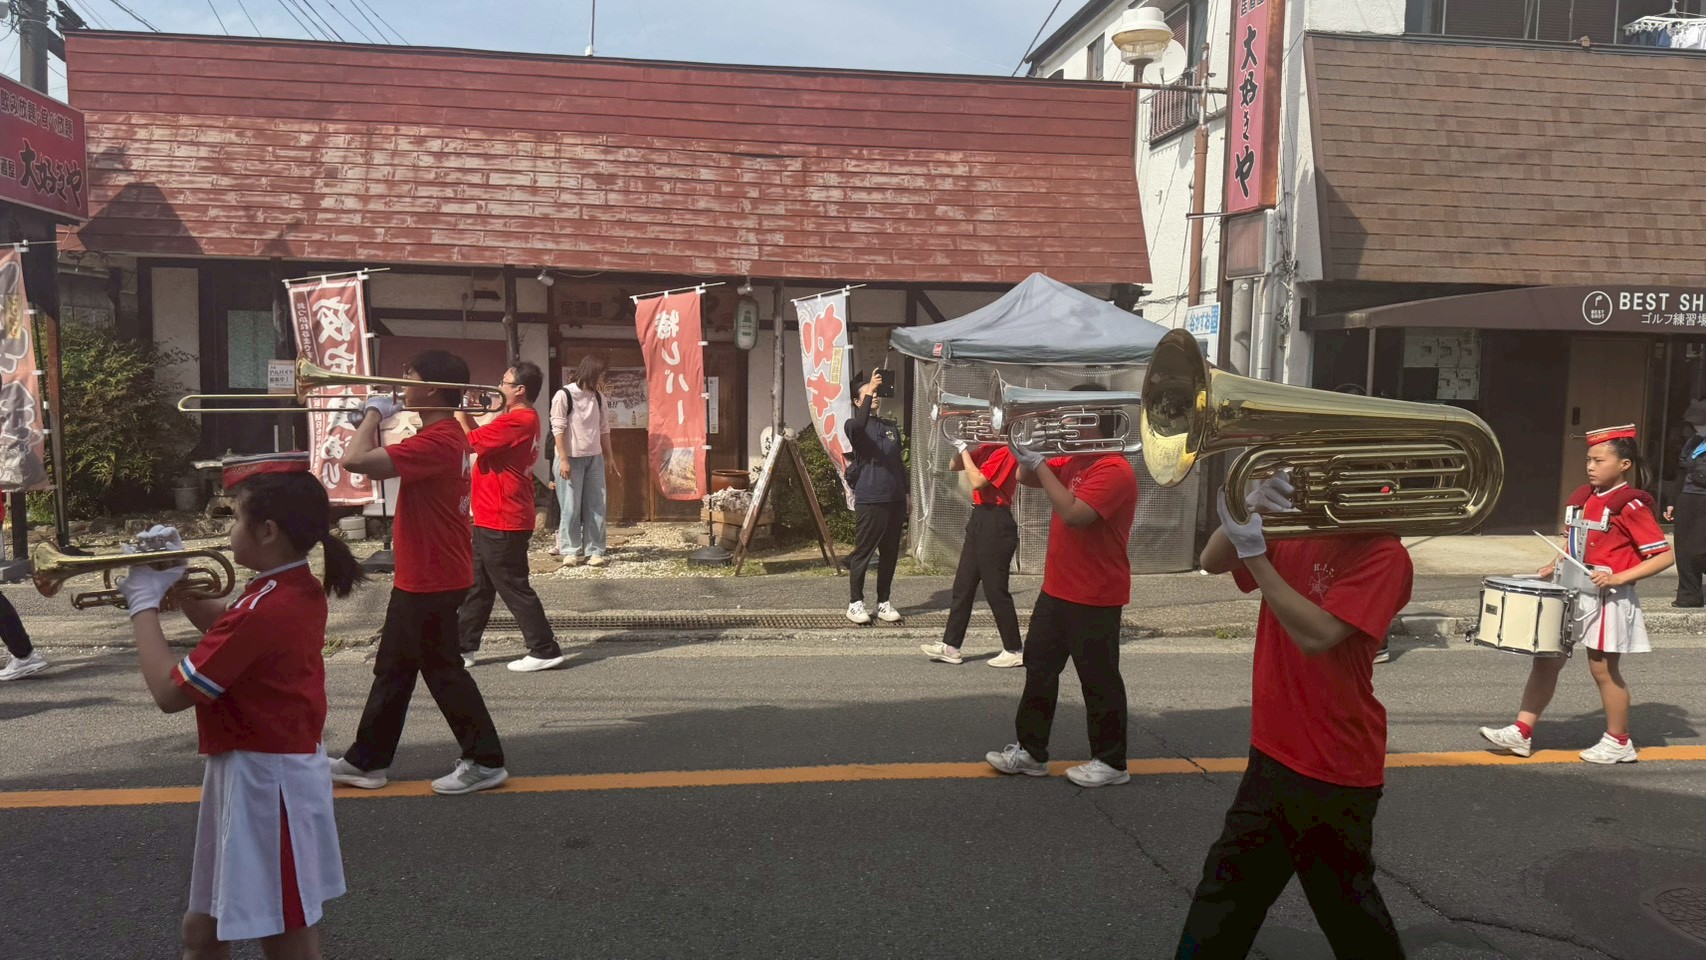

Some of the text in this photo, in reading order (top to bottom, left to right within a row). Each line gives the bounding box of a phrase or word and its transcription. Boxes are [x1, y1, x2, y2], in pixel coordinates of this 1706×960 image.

[1234, 25, 1258, 200] 大好きや
[19, 138, 83, 210] 大好きや
[1619, 291, 1704, 312] BEST SH
[1641, 311, 1706, 327] ゴルフ練習場
